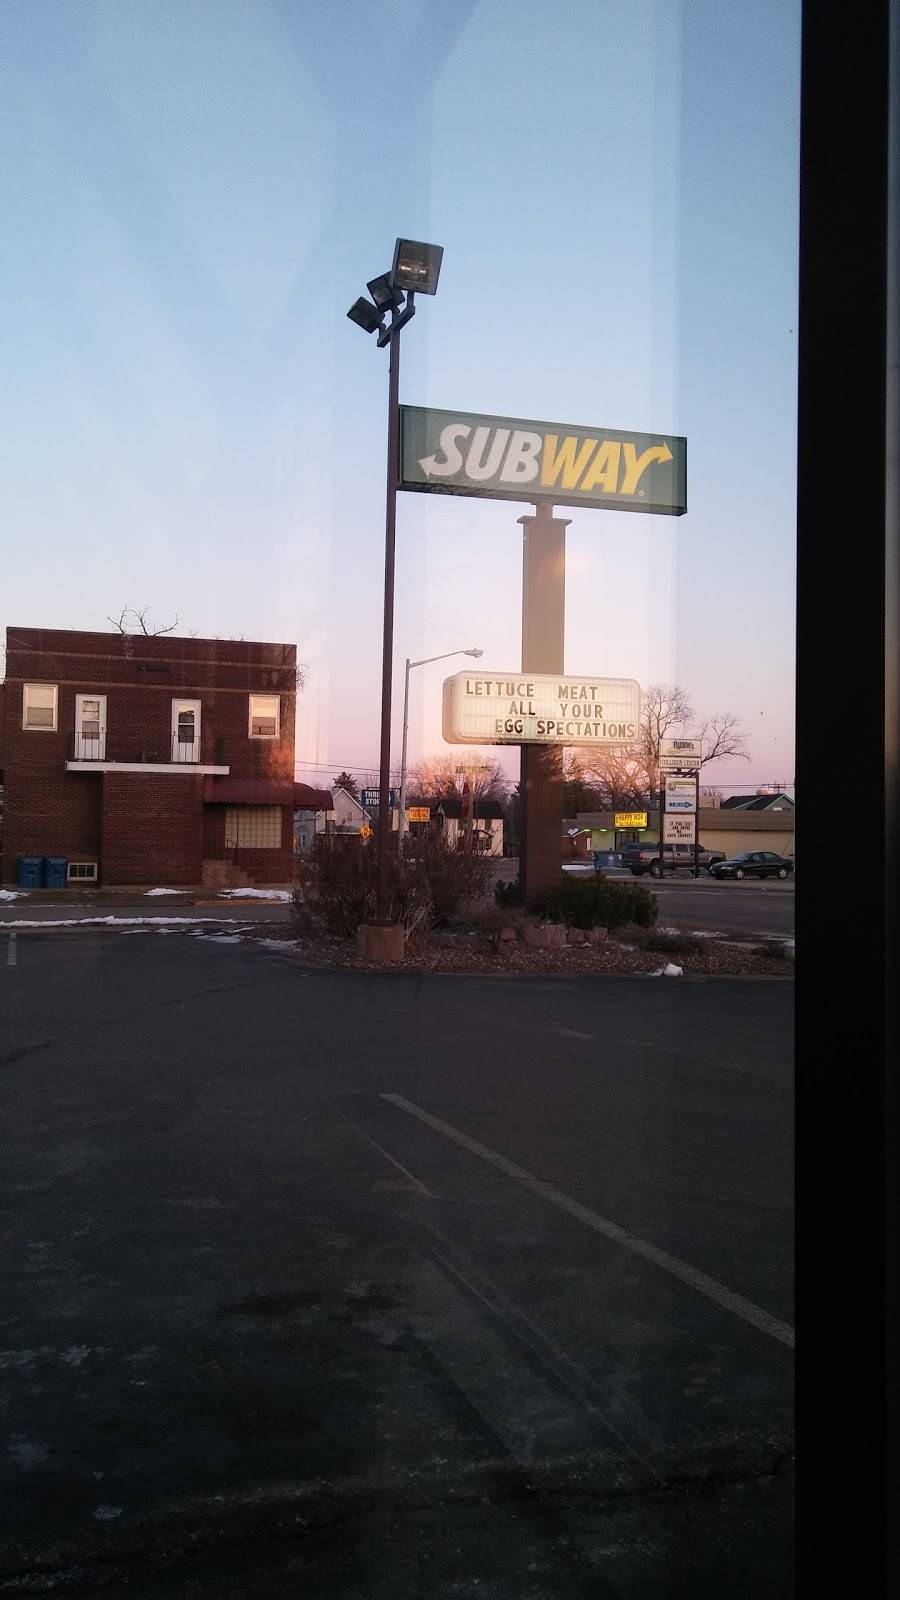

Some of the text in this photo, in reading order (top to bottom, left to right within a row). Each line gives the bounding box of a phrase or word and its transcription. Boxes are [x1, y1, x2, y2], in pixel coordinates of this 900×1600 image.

[418, 423, 673, 496] SUBWAY
[466, 680, 598, 701] LETTUCE MEAT
[509, 701, 604, 719] ALL YOUR
[495, 719, 635, 738] EGG SPECTATIONS
